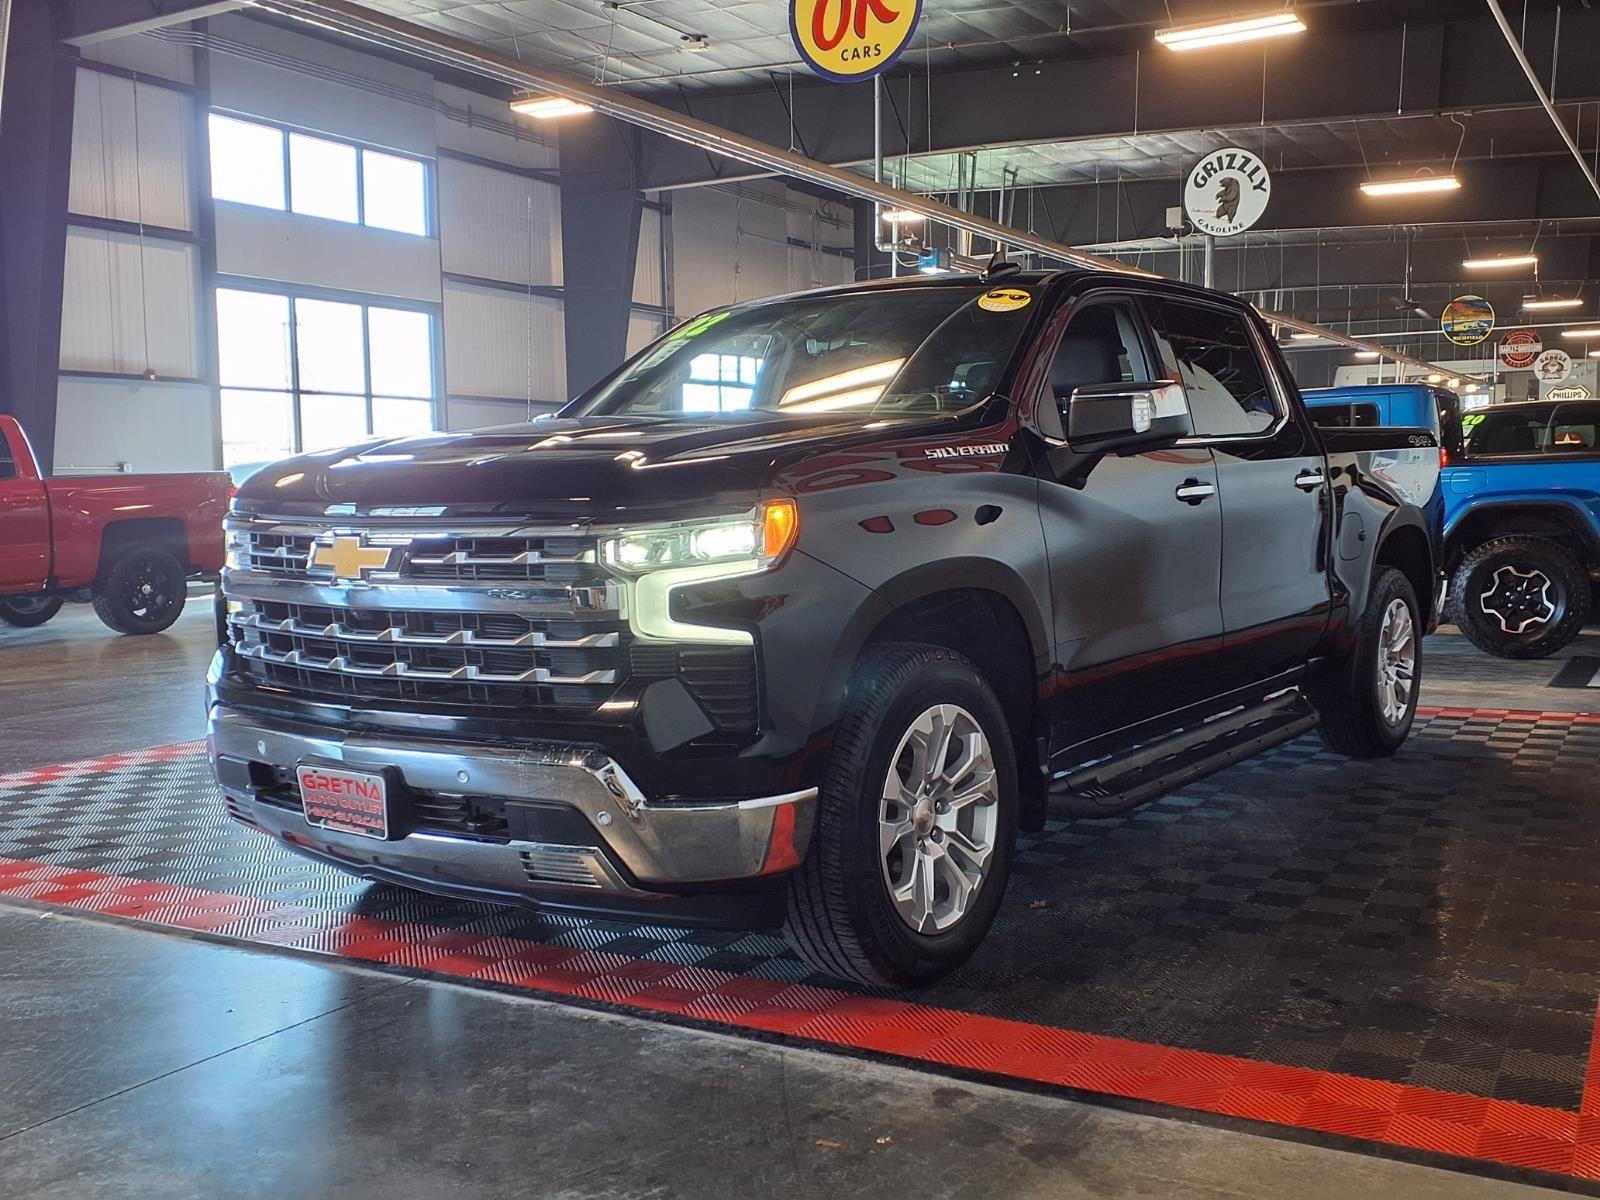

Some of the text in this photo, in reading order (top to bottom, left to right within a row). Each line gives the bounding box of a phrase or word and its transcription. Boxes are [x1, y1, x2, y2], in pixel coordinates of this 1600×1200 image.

[840, 43, 882, 61] CARS
[1193, 153, 1267, 192] GRIZZLY
[1197, 218, 1245, 233] GASOLINE
[1552, 391, 1582, 399] PHILLIPS
[1462, 414, 1486, 426] 20
[924, 443, 1010, 460] SILVERADO
[302, 774, 382, 801] GRETNA
[306, 793, 384, 816] AUTO OUTLET
